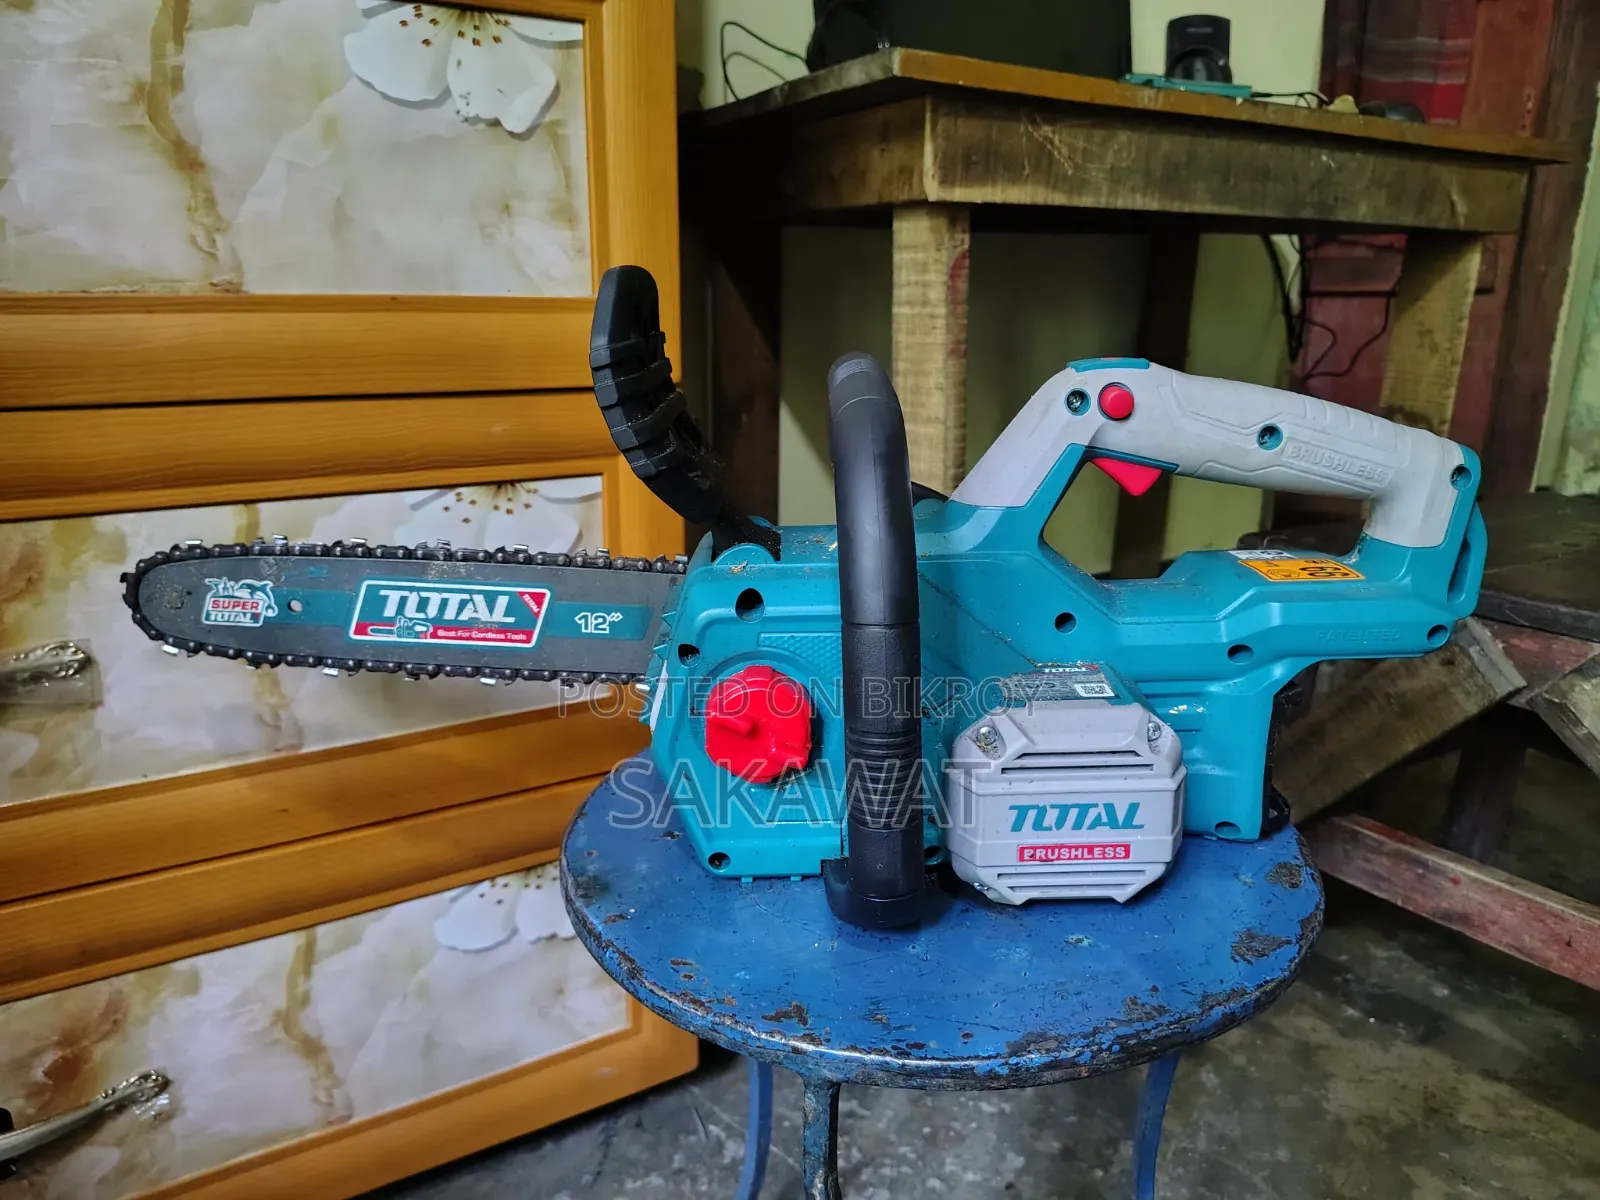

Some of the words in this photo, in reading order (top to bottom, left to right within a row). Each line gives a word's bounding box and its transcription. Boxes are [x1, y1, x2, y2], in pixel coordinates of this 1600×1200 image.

[1288, 443, 1387, 483] BRUSHLESS
[211, 599, 260, 611] SUPER
[379, 590, 515, 623] TOTAL
[522, 593, 541, 613] TOTAL
[209, 612, 255, 623] TOTAL
[437, 629, 456, 637] Best
[457, 630, 471, 638] For
[471, 631, 506, 640] Cordless
[506, 633, 528, 641] Tools
[1008, 802, 1145, 832] TOTAL
